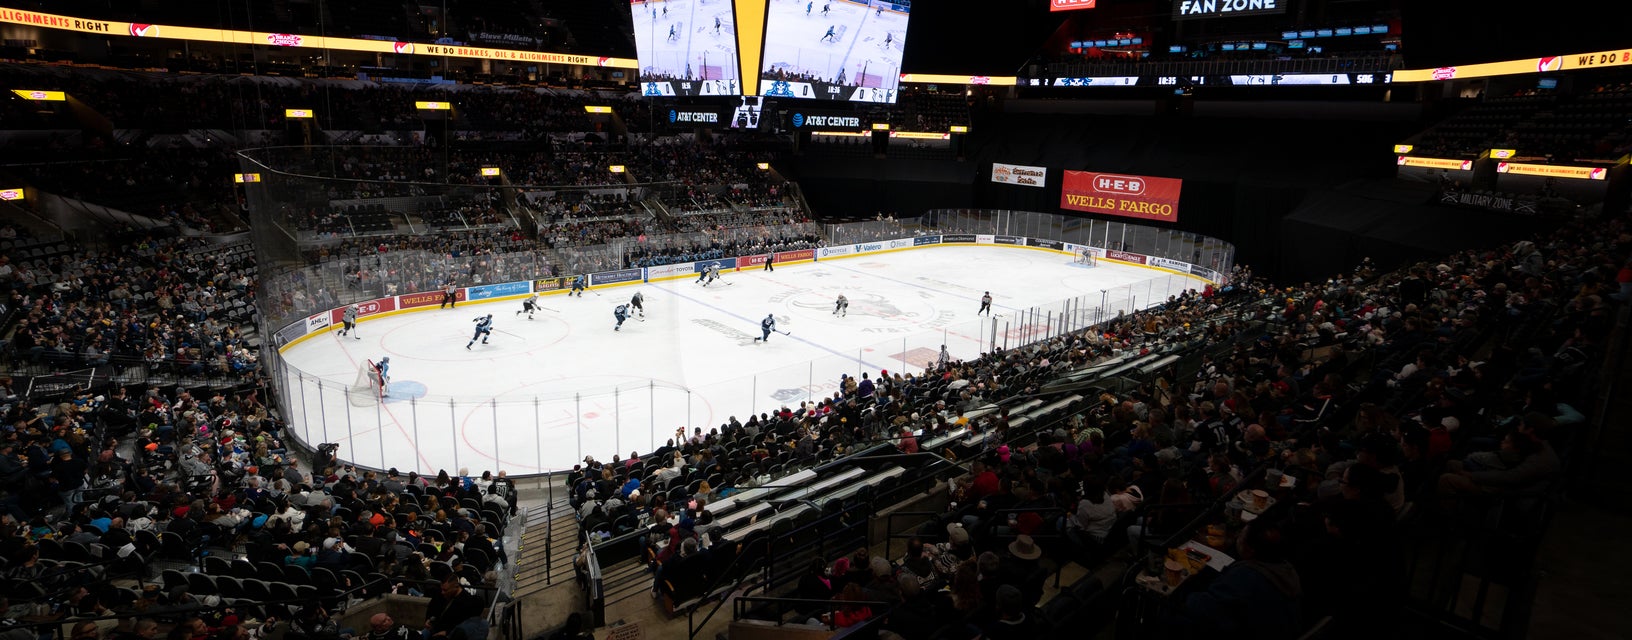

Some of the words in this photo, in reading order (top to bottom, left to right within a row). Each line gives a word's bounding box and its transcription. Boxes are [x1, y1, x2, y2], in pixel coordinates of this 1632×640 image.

[1180, 0, 1217, 15] FAN
[1221, 0, 1276, 12] ZONE
[0, 10, 70, 28] LIGNMENTS
[75, 19, 109, 32] RIGHT
[427, 46, 439, 54] WE
[443, 47, 454, 55] DO
[457, 48, 491, 58] BRAKES,
[519, 53, 565, 63] ALIGNMENTS
[567, 56, 588, 65] RIGHT
[1579, 55, 1595, 66] WE
[1600, 53, 1616, 64] DO
[1623, 51, 1632, 62] B
[1384, 74, 1391, 84] 3
[677, 111, 692, 122] AT&T
[692, 112, 718, 123] CENTER
[805, 115, 827, 126] AT&T
[827, 116, 860, 128] CENTER
[1066, 193, 1116, 211] WELLS
[1119, 199, 1173, 217] FARGO
[1460, 193, 1493, 208] MILITARY
[1493, 197, 1514, 211] ZONE
[863, 244, 882, 252] Valero
[676, 266, 693, 274] TOYOTA
[403, 294, 433, 306] WELLS
[435, 291, 463, 302] FAO
